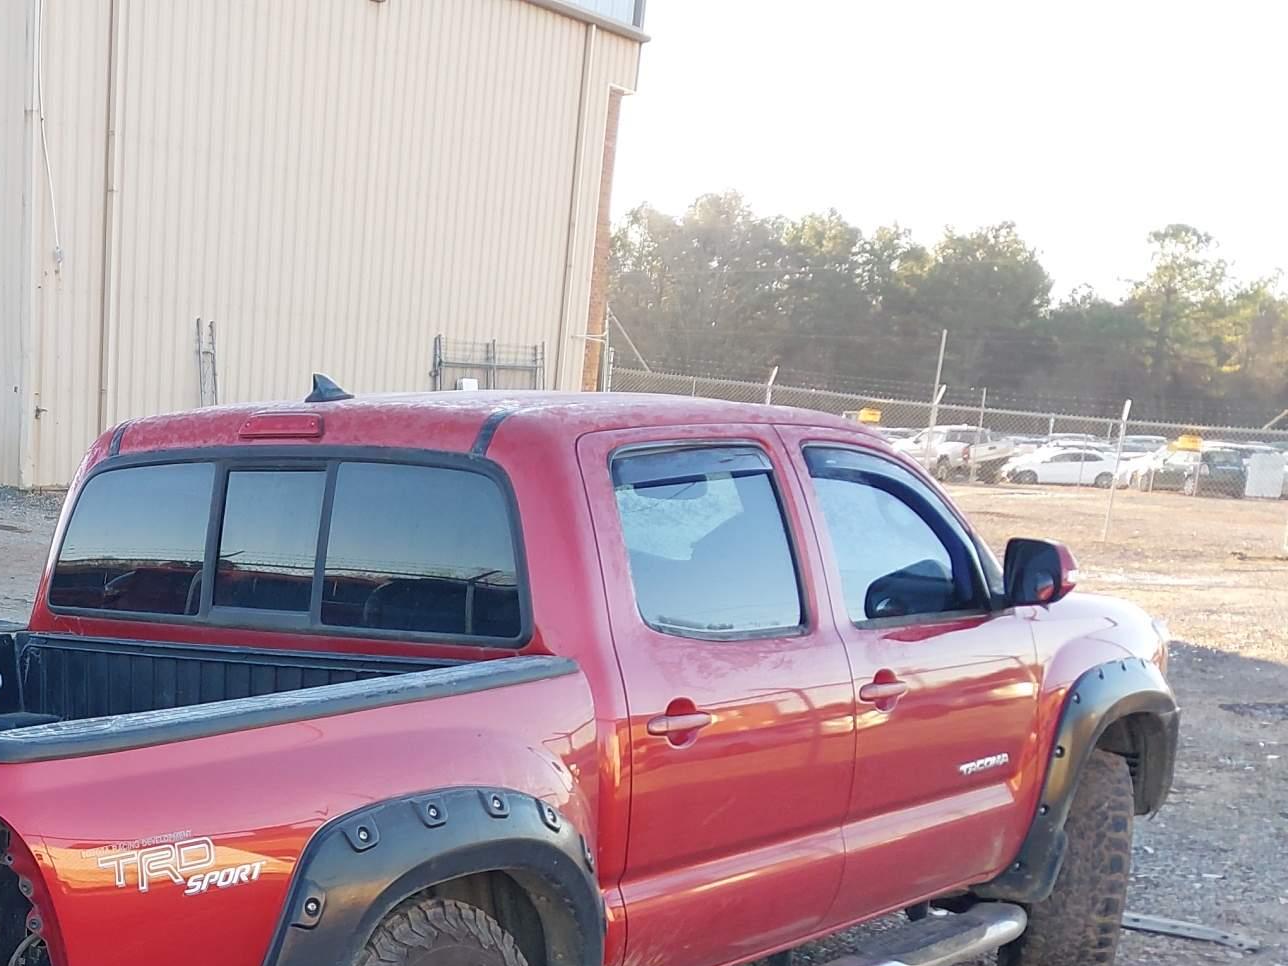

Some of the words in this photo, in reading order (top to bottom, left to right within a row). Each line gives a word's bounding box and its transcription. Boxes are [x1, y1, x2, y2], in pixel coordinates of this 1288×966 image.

[959, 752, 1009, 775] TACOMA
[98, 836, 216, 893] TRD
[183, 860, 268, 896] SPORT
